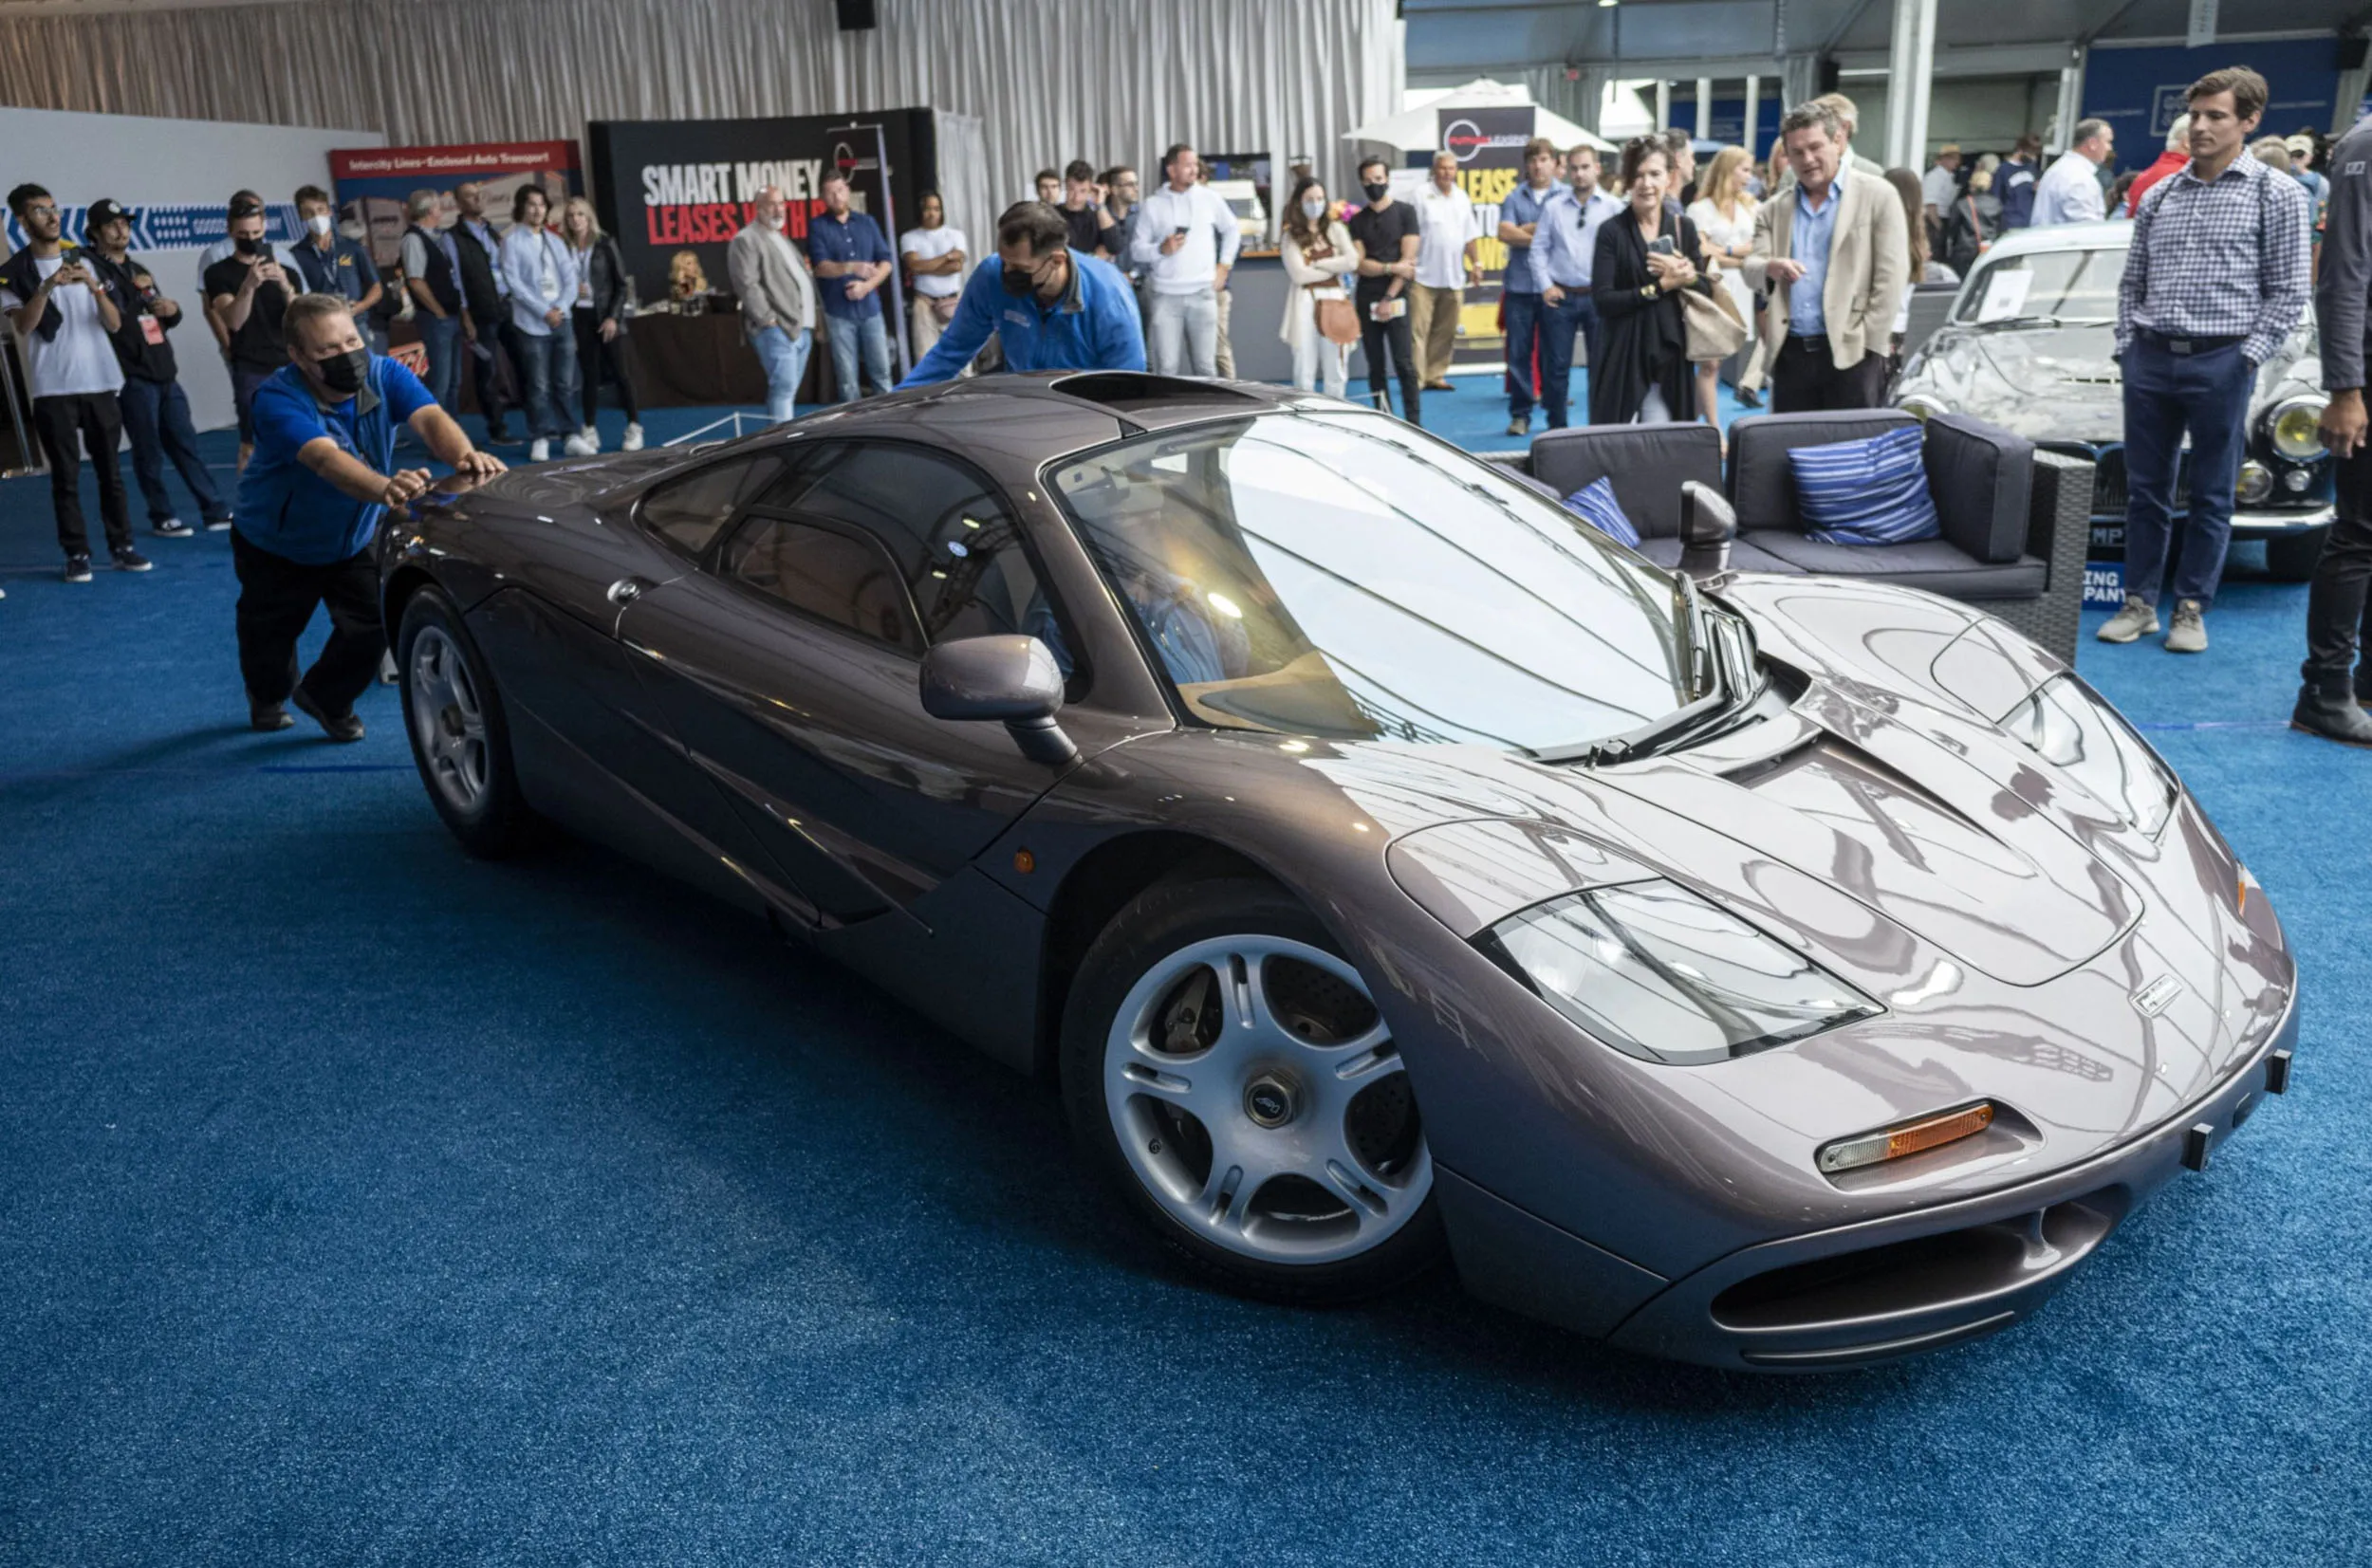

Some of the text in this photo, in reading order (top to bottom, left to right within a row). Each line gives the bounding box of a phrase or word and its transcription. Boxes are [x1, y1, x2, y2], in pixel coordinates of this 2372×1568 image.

[348, 159, 392, 171] Intercity
[474, 154, 498, 165] Auto
[499, 152, 549, 164] Transport
[641, 159, 823, 206] SMART MONEY
[646, 200, 739, 246] LEASES
